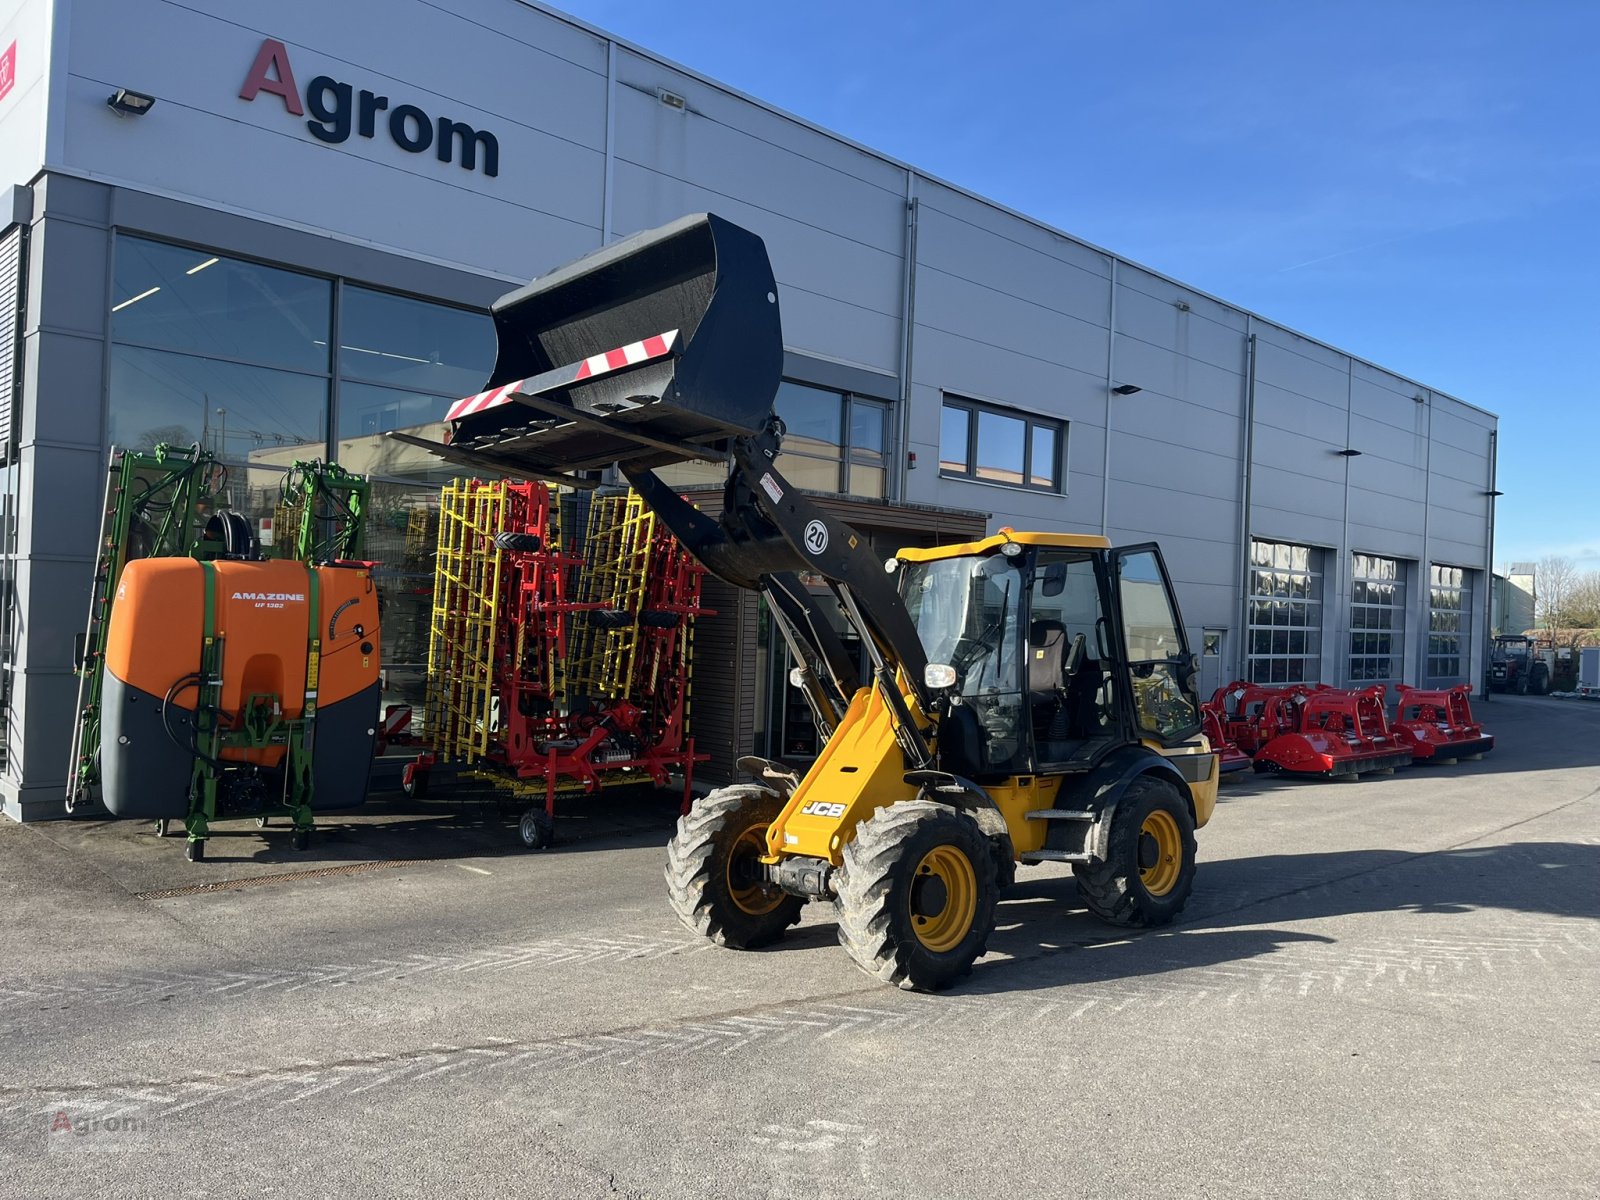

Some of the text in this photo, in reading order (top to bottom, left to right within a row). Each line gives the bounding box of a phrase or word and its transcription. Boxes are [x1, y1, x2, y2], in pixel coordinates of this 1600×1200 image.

[239, 38, 499, 178] Agrom
[808, 525, 825, 548] 20
[231, 592, 305, 601] AMAZONE
[801, 801, 847, 817] JCB
